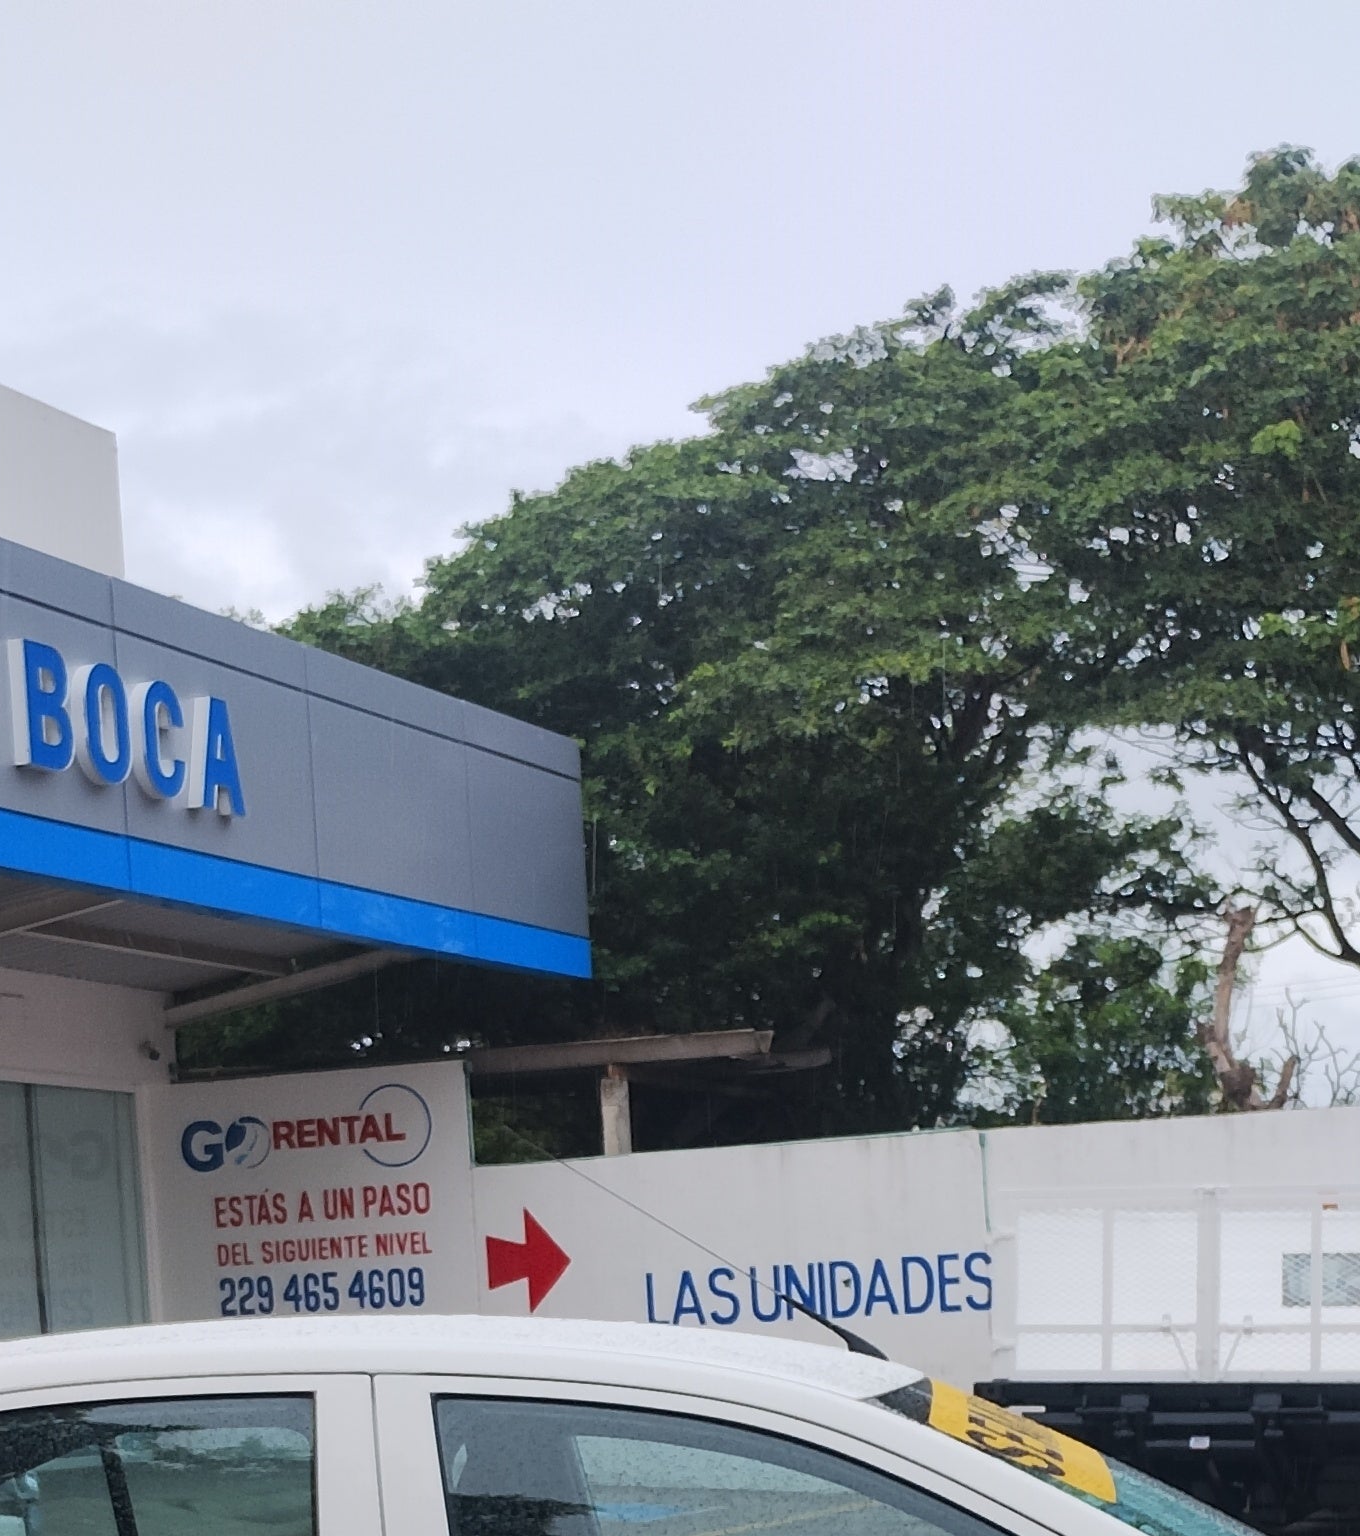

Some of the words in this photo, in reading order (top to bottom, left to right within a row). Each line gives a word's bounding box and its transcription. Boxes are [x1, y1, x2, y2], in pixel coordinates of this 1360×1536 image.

[8, 638, 246, 816] BOCA
[272, 1113, 406, 1149] RENTAL
[214, 1187, 288, 1228] ESTÁS
[297, 1191, 315, 1223] A
[323, 1187, 355, 1221] UN
[362, 1182, 431, 1218] PASO
[217, 1243, 254, 1267] DEL
[261, 1234, 368, 1264] SIGUIENTE
[375, 1231, 433, 1256] NIVEL
[219, 1275, 275, 1317] 229
[283, 1271, 339, 1313] 465
[348, 1267, 426, 1309] 4609
[645, 1267, 741, 1326] LAS
[749, 1252, 993, 1323] UNIDADES
